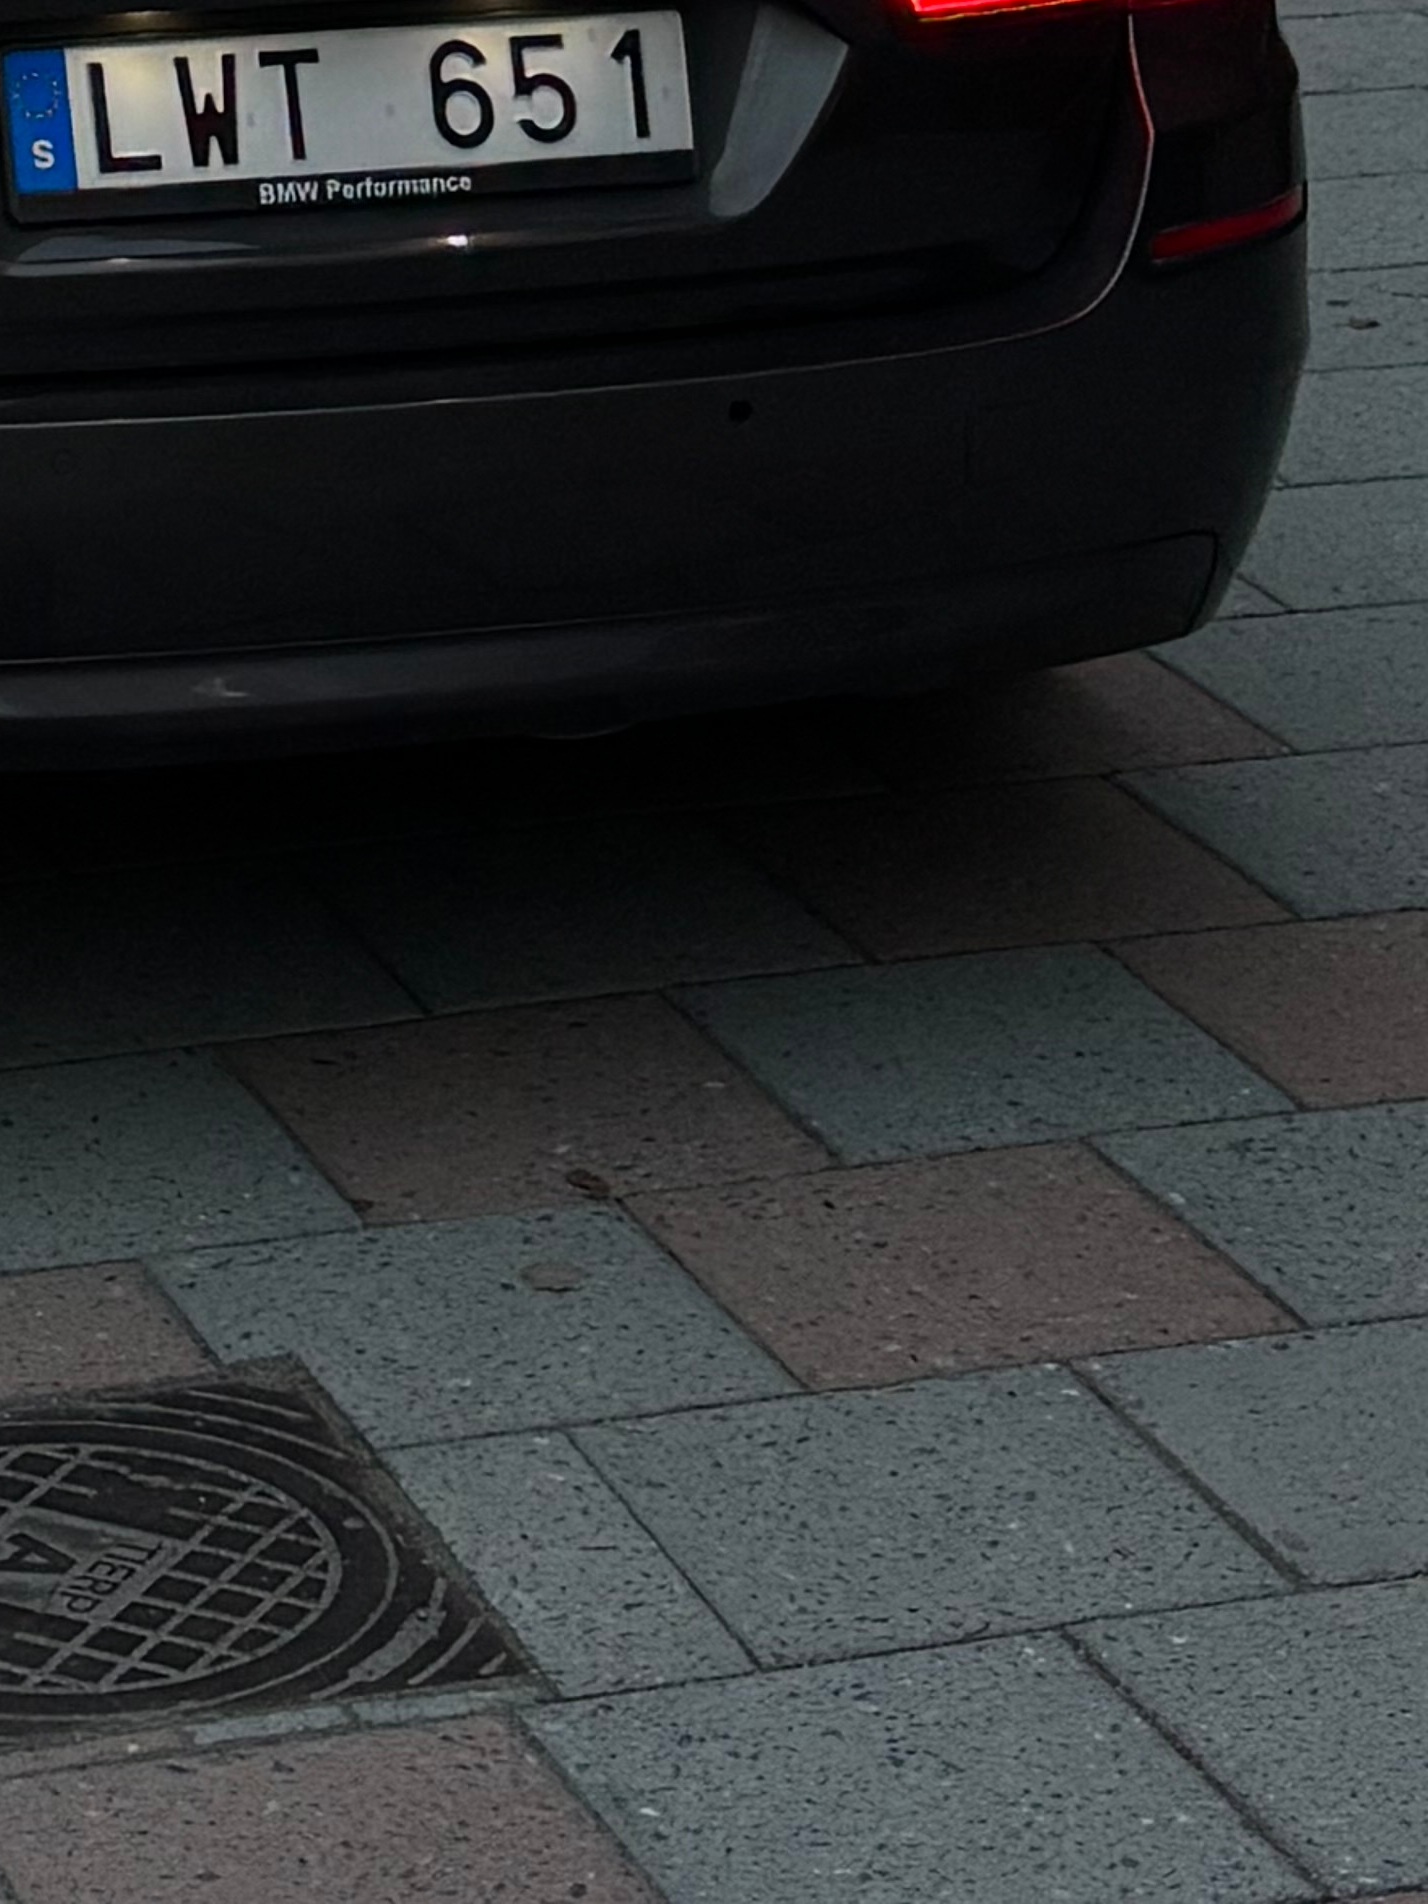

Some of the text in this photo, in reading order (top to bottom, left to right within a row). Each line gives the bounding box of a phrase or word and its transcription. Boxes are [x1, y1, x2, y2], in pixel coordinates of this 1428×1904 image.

[85, 27, 653, 174] LWT 651
[31, 138, 55, 171] S
[259, 176, 472, 205] BMW Performance
[59, 1540, 163, 1613] TIERP
